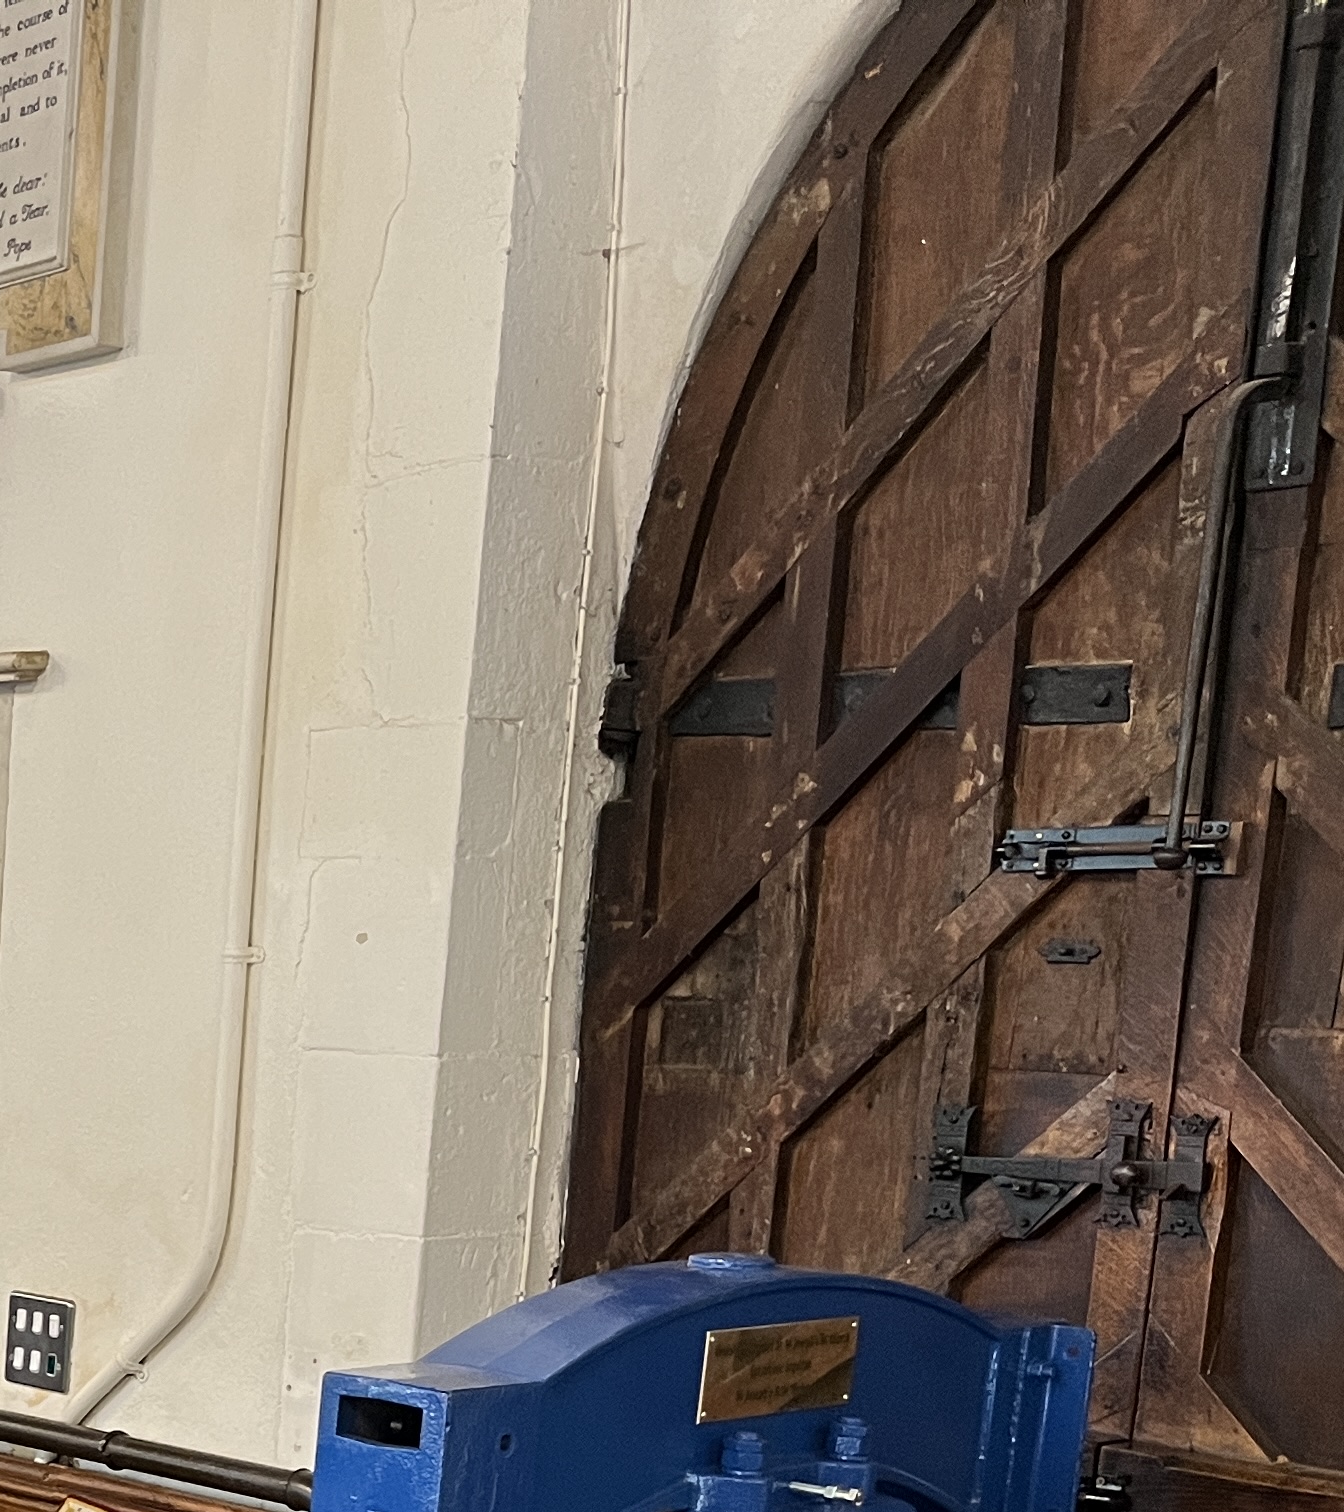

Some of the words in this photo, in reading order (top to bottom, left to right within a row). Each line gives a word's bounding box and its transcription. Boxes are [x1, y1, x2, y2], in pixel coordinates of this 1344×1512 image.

[17, 8, 54, 32] course
[58, 0, 70, 16] of
[25, 37, 57, 58] never
[42, 61, 55, 80] of
[19, 96, 41, 117] and
[45, 95, 58, 109] to
[9, 213, 18, 226] a
[3, 237, 33, 262] Pope
